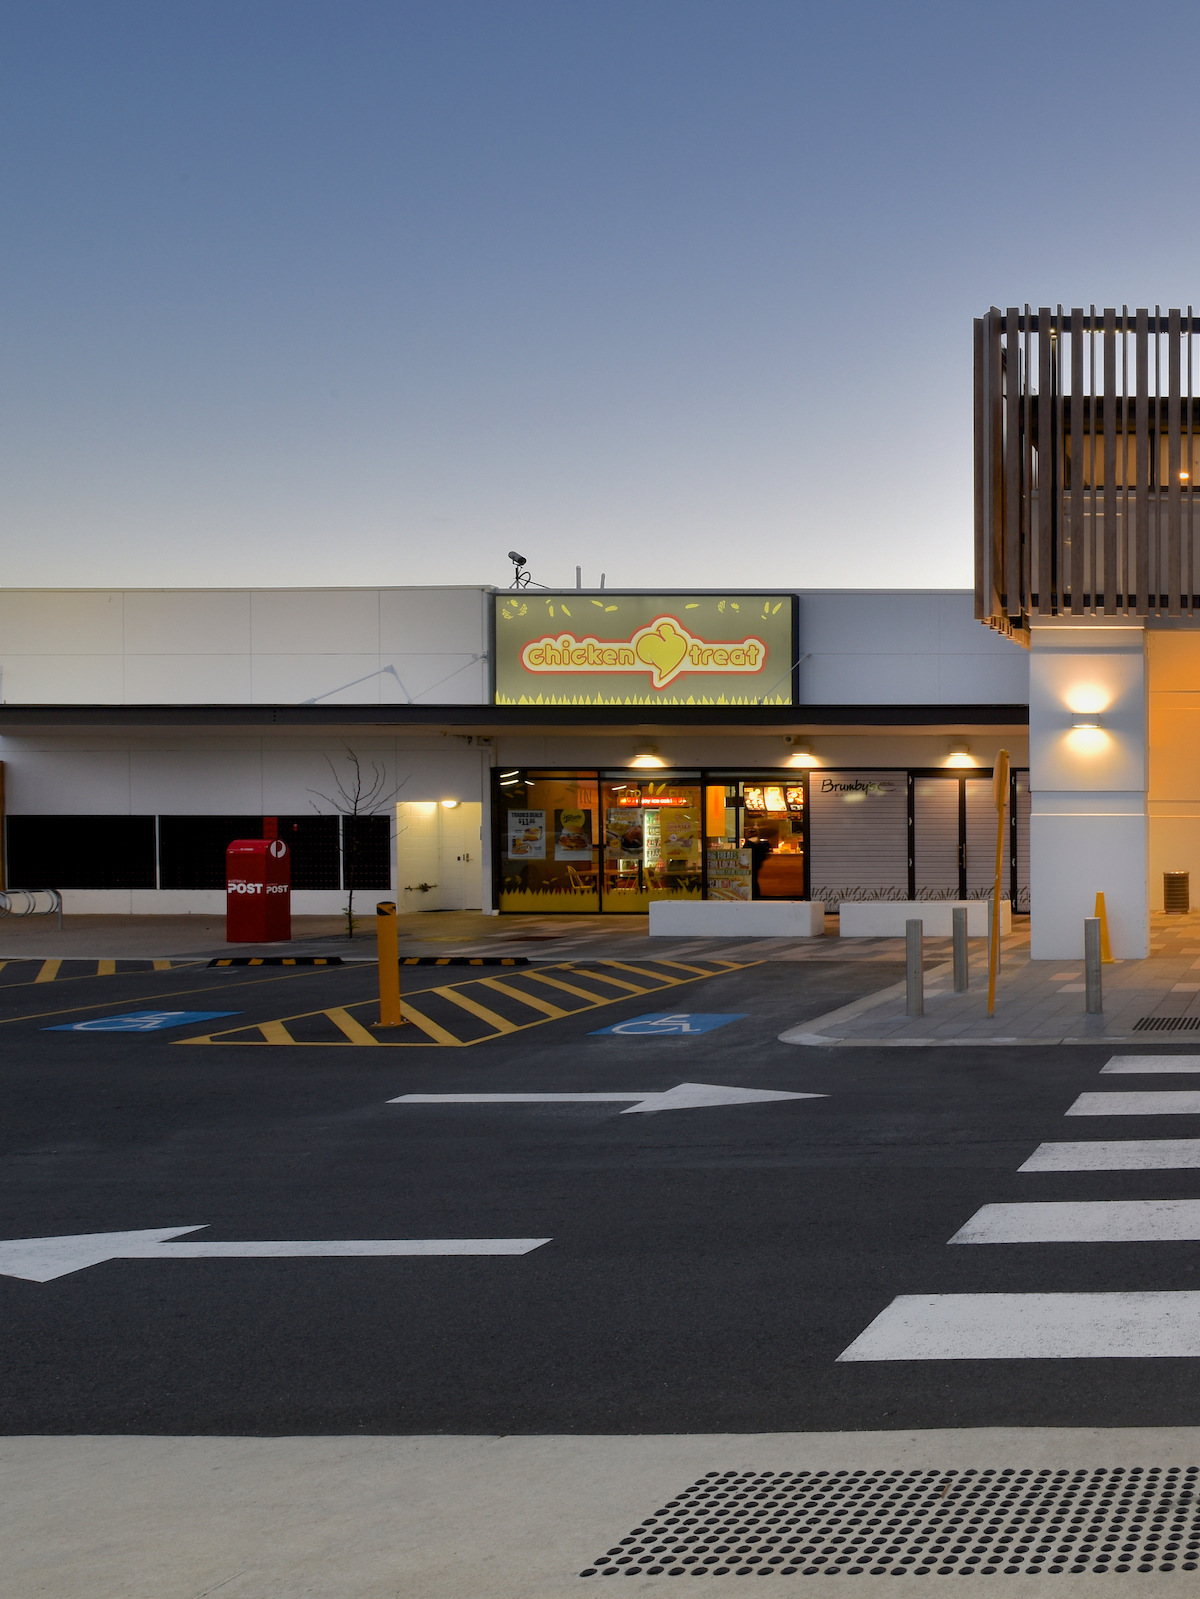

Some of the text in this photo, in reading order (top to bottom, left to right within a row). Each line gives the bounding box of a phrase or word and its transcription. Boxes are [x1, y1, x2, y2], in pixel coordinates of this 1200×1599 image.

[528, 640, 761, 666] chicken treat
[820, 778, 876, 796] Brumby's
[227, 883, 264, 894] POST
[266, 885, 289, 894] POST
